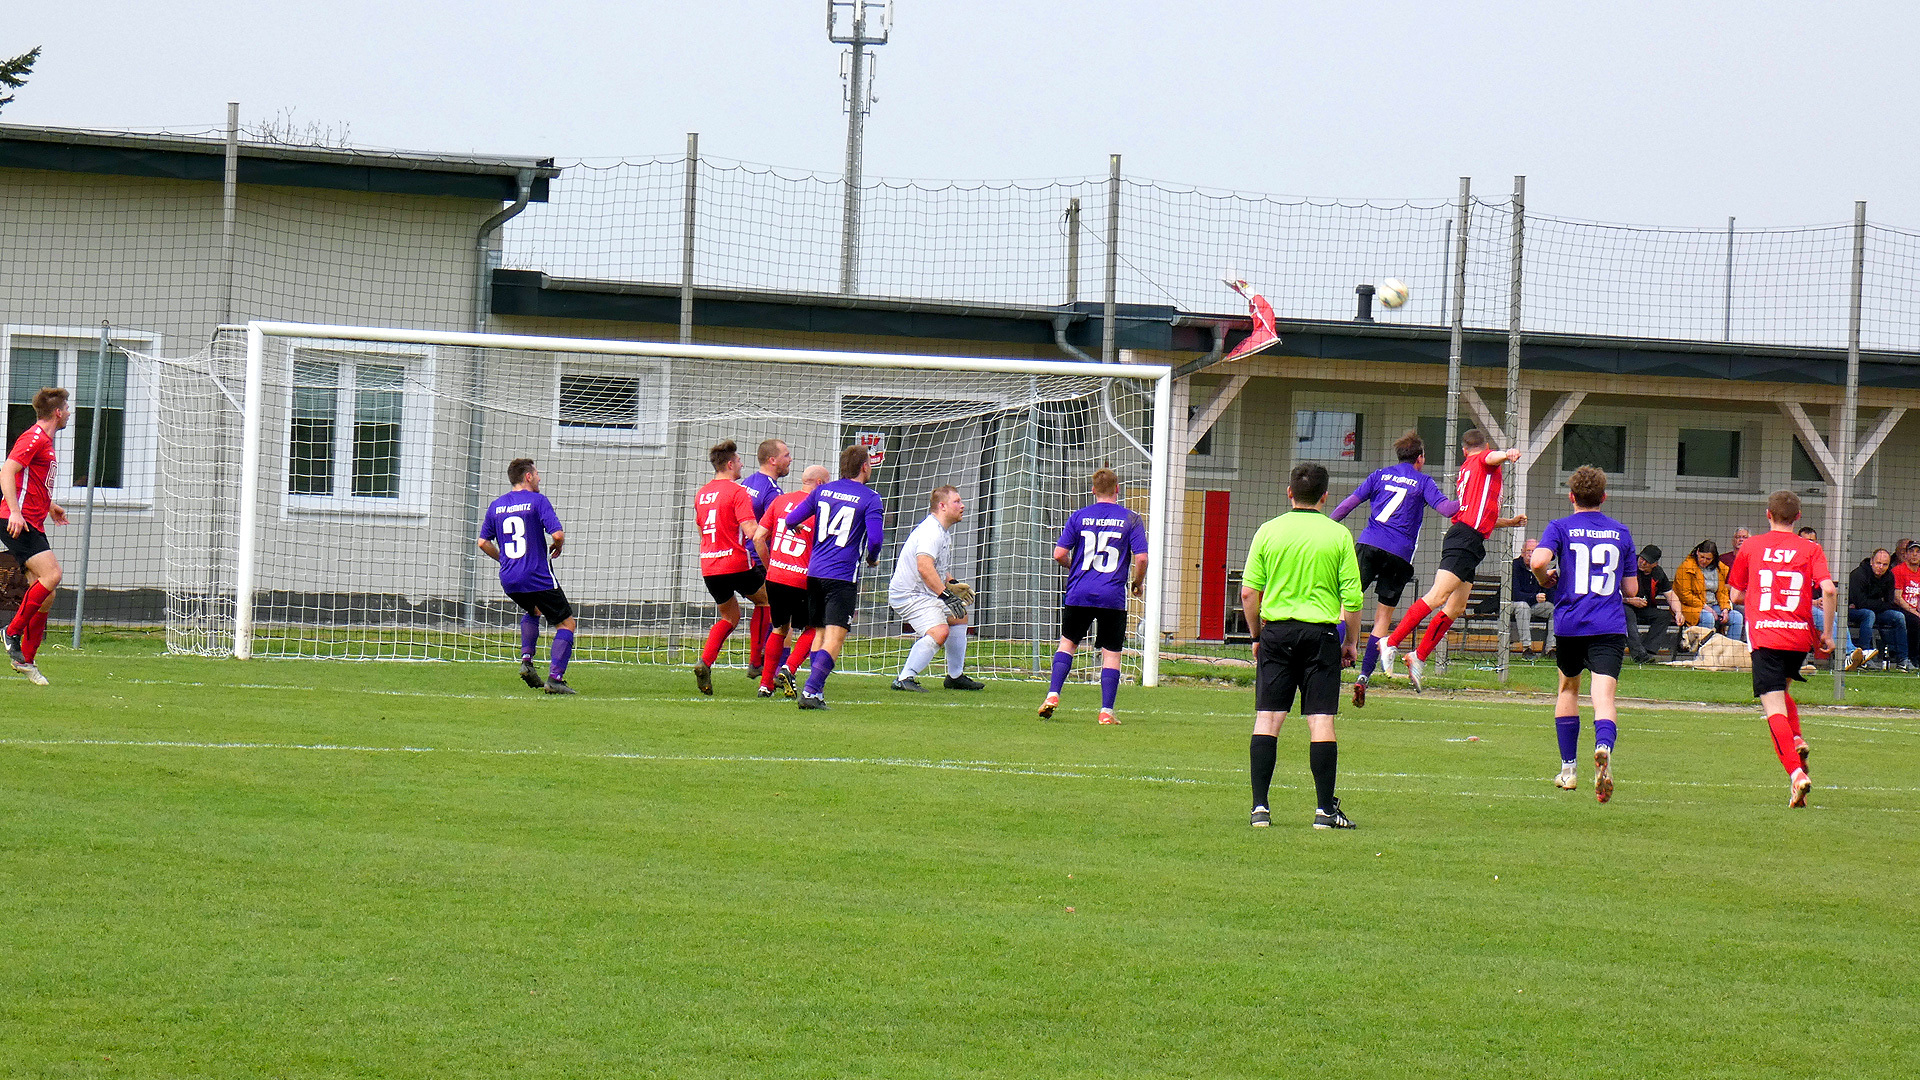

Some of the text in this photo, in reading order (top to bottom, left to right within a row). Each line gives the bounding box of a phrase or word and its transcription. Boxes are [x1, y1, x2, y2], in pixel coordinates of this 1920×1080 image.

[699, 491, 719, 505] LSV
[820, 489, 834, 498] FSV
[1375, 484, 1408, 523] 7
[502, 516, 527, 559] 3
[702, 509, 717, 543] 4
[772, 518, 812, 557] 16
[817, 500, 856, 548] 14
[1082, 518, 1095, 526] FSV
[1569, 528, 1585, 537] FSV
[1080, 530, 1122, 574] 15
[1569, 542, 1620, 597] 13
[1762, 547, 1797, 563] LSV
[1758, 569, 1804, 613] 13
